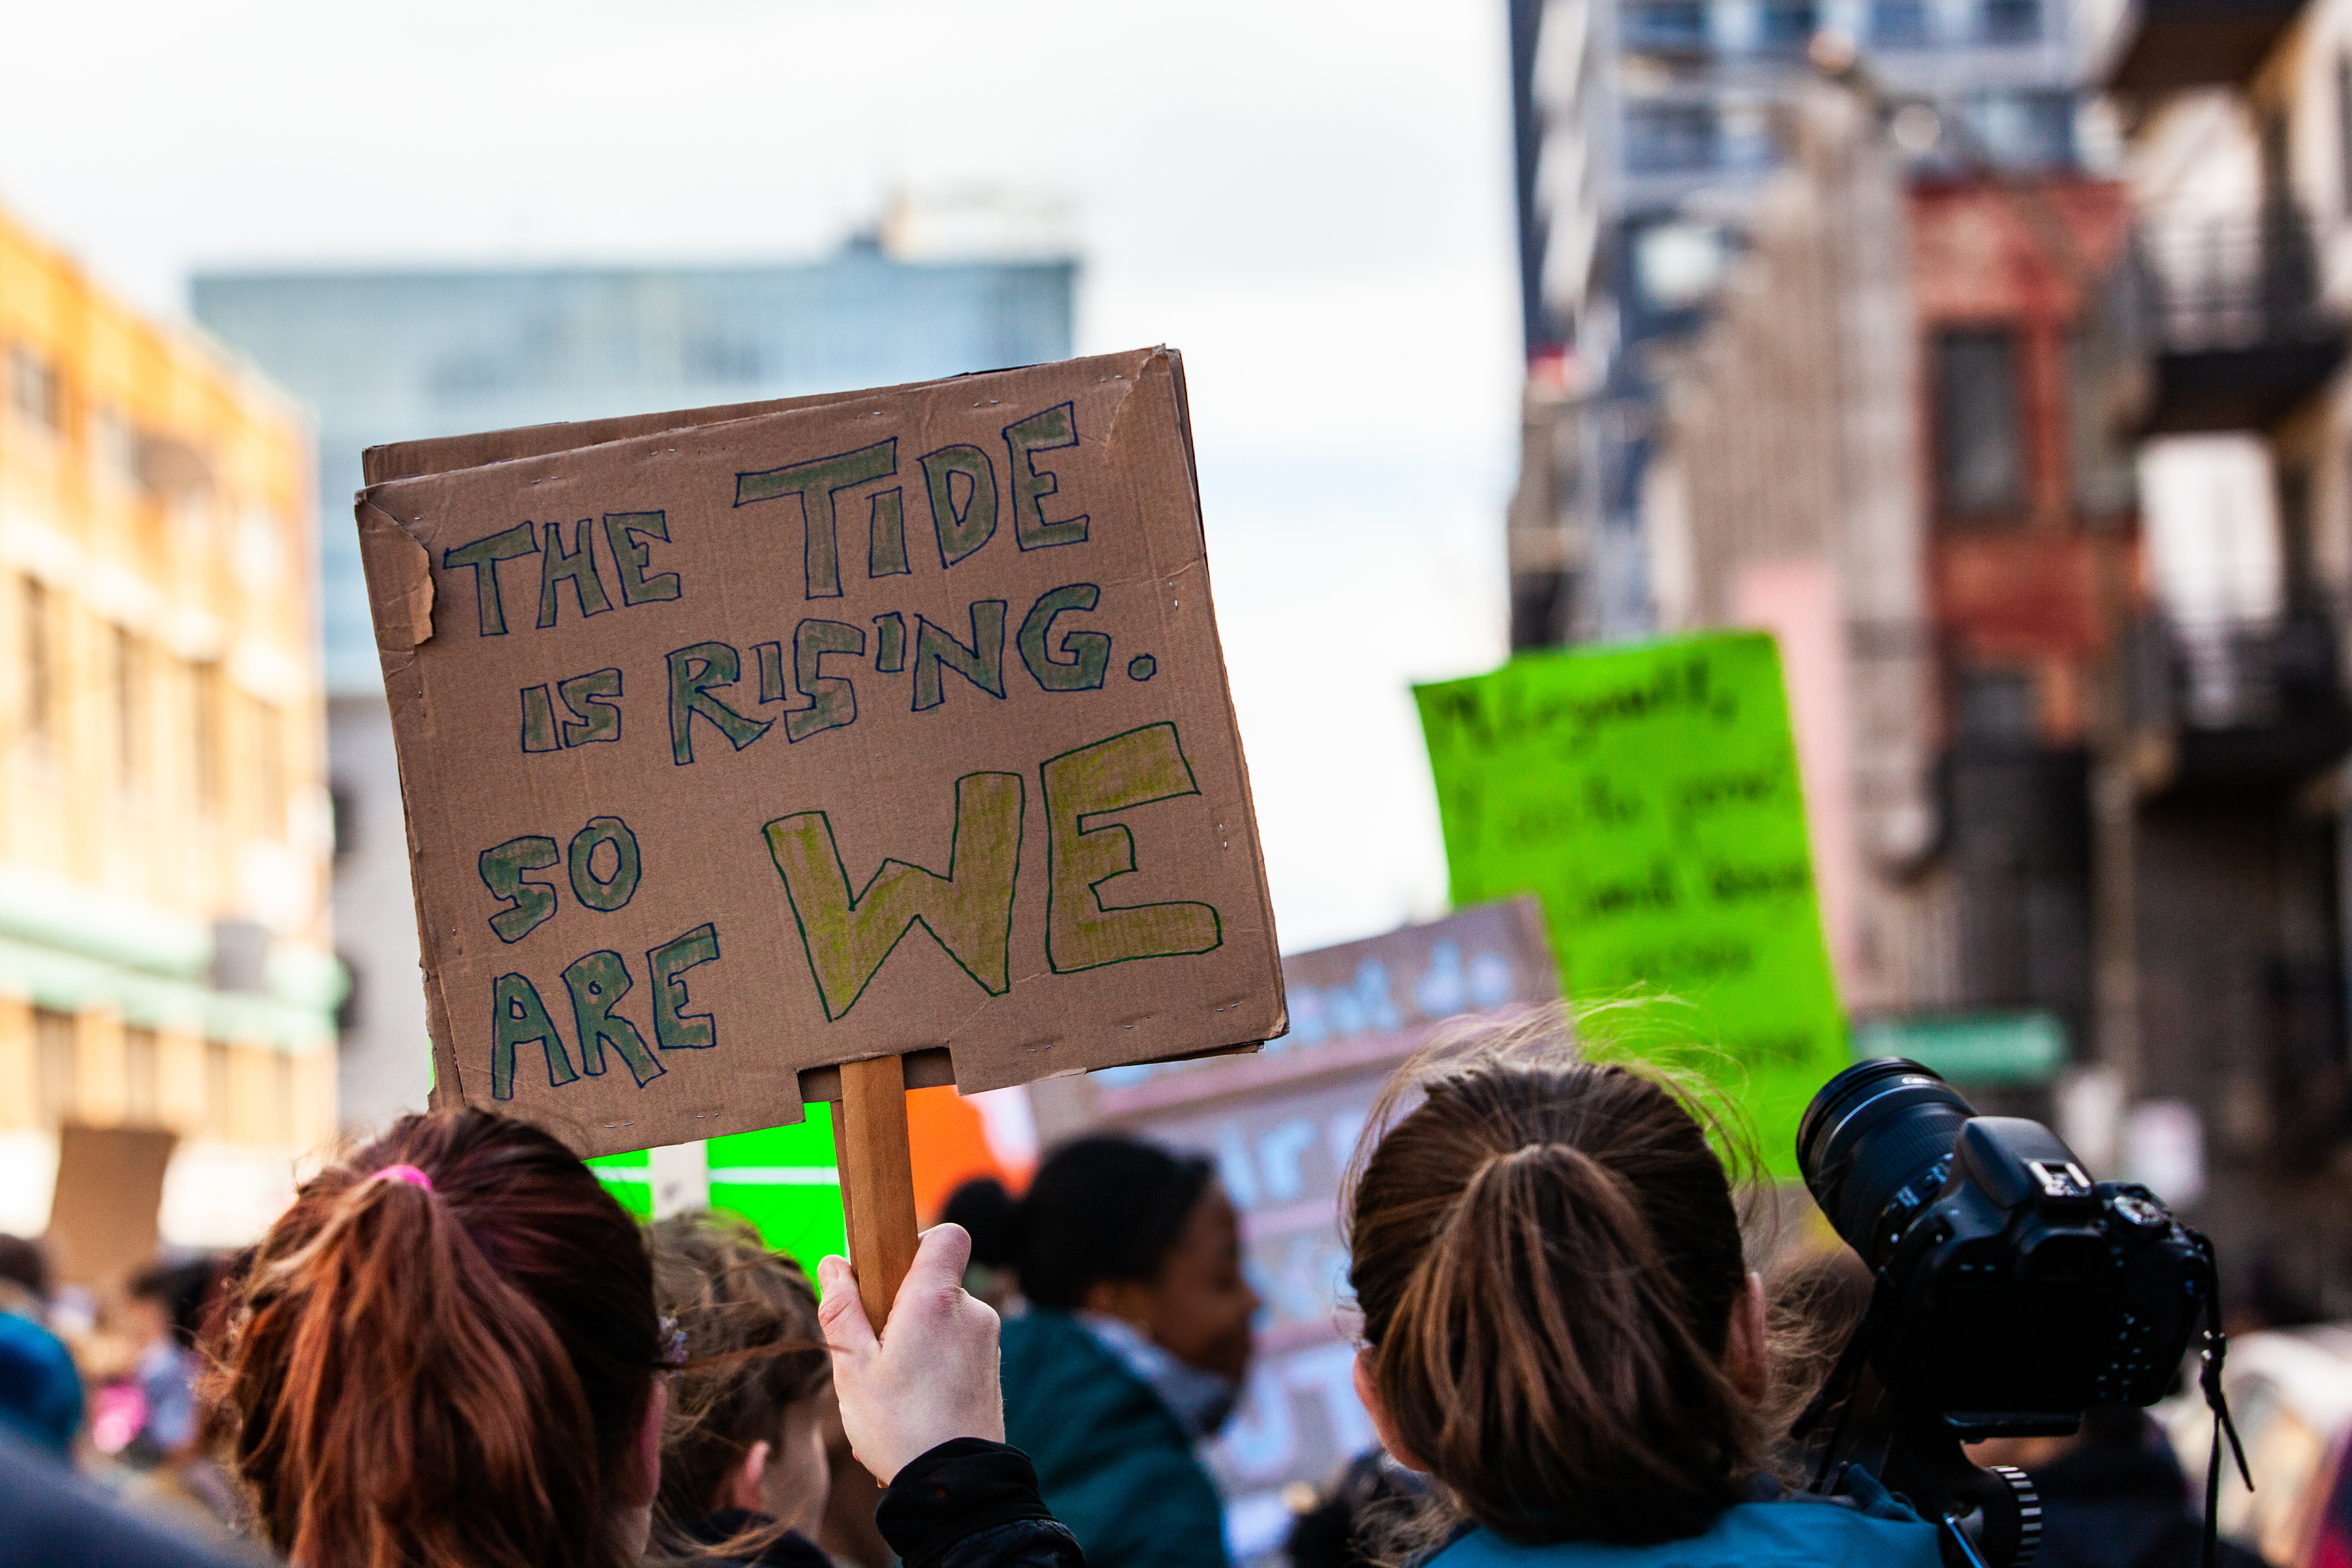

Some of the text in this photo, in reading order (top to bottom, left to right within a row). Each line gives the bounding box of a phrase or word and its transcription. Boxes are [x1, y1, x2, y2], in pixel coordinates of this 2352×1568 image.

[443, 401, 1090, 637] THE TIDE
[520, 583, 1158, 766] IS RISING.
[479, 816, 642, 944] SO
[761, 721, 1223, 1023] WE
[492, 922, 720, 1101] ARE
